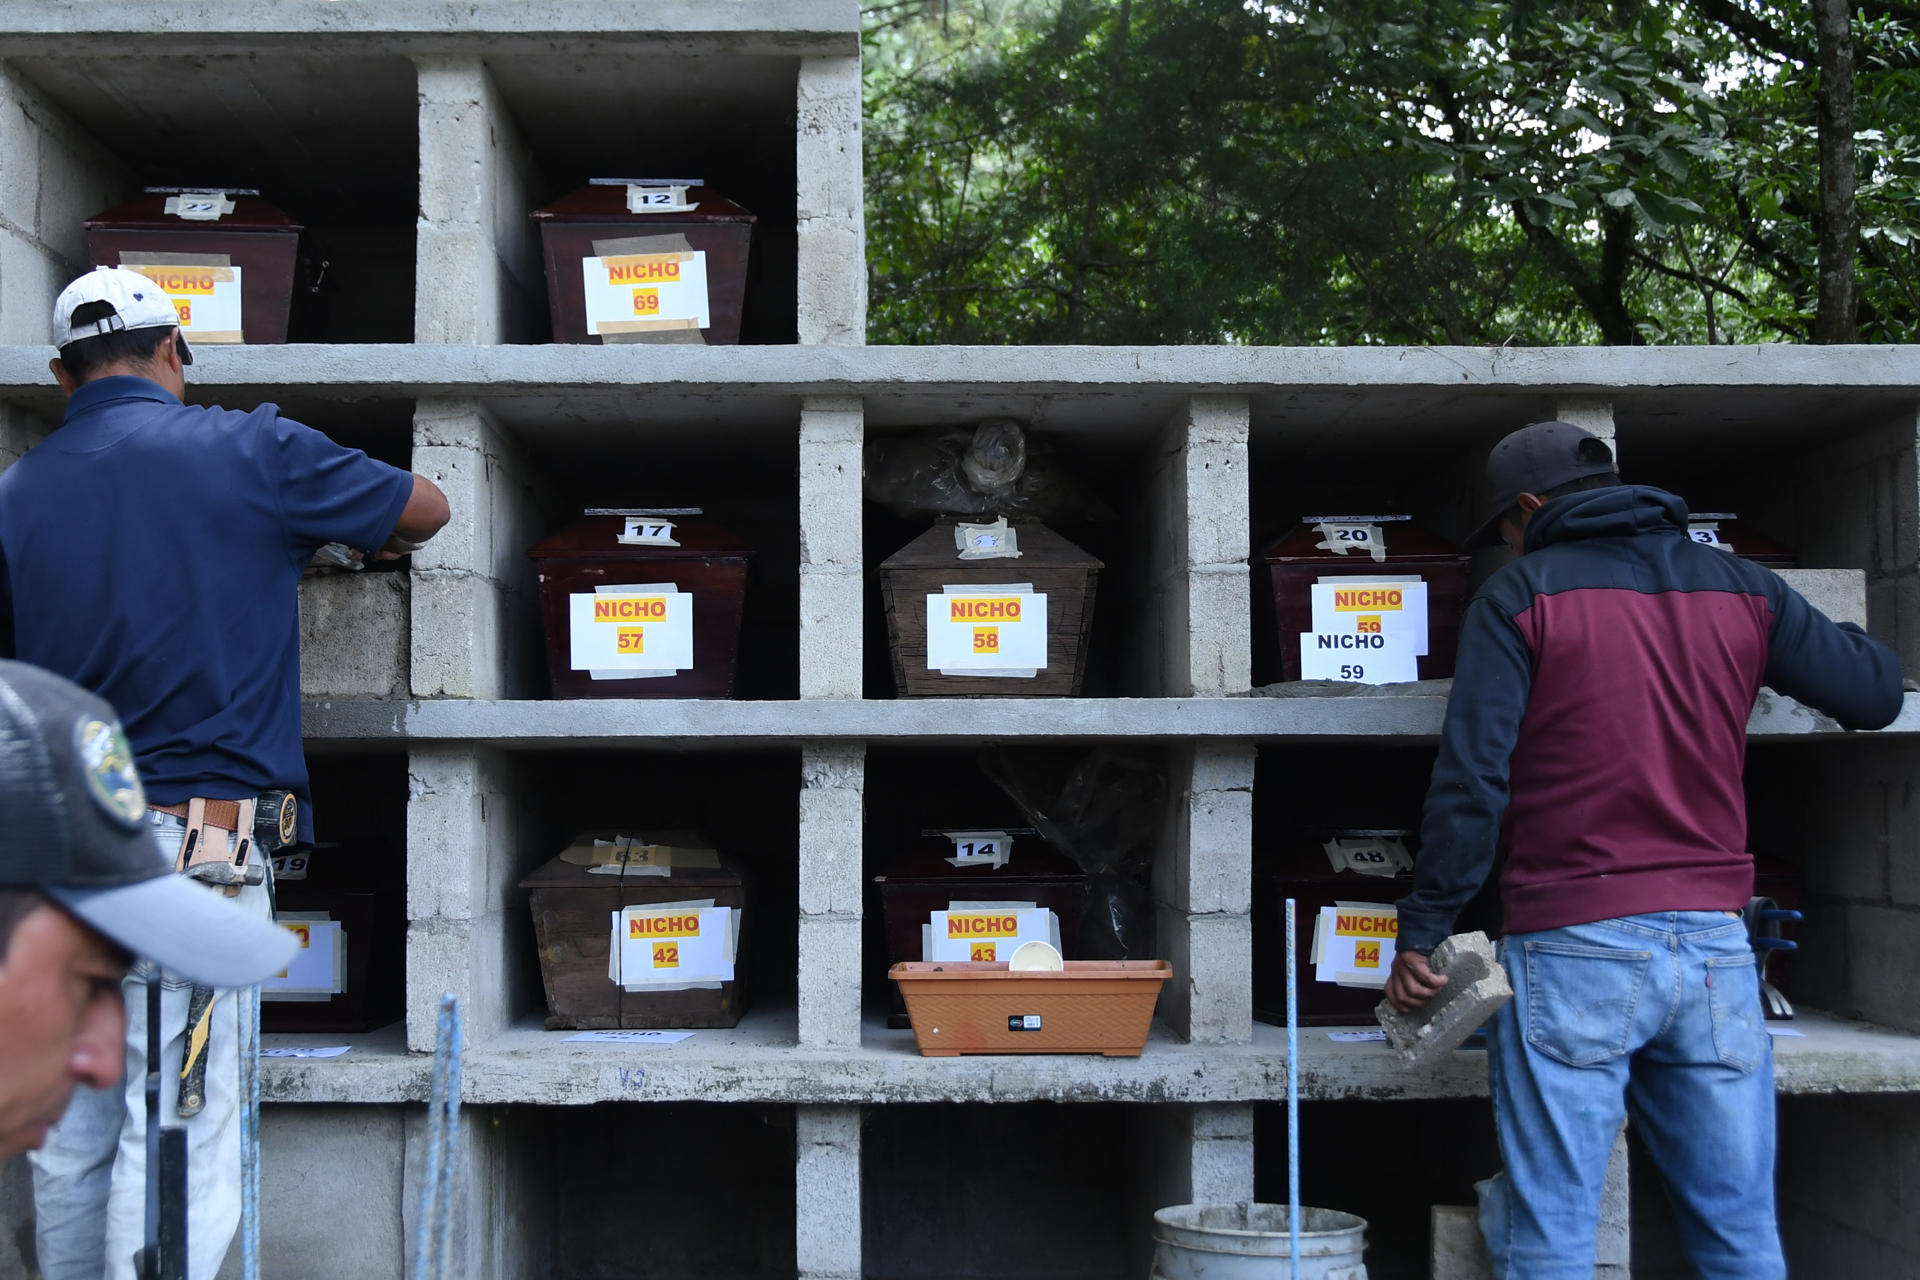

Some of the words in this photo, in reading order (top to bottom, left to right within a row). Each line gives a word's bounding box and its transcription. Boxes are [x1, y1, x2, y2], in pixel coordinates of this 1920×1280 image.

[640, 194, 671, 204] 12
[609, 262, 680, 280] NICHO
[633, 295, 659, 310] 69
[631, 525, 666, 537] 17
[1337, 530, 1368, 541] 20
[1335, 591, 1402, 606] NICHO
[595, 602, 666, 617] NICHO
[951, 602, 1021, 617] NICHO
[1357, 621, 1382, 633] 59
[618, 633, 643, 648] 57
[974, 633, 999, 648] 58
[1318, 634, 1385, 649] NICHO
[1340, 664, 1364, 679] 59
[962, 843, 996, 856] 14
[274, 858, 306, 871] 19
[1353, 852, 1385, 863] 48
[629, 916, 699, 934] NICHO
[948, 917, 1018, 933] NICHO
[653, 948, 679, 963] 42
[970, 948, 996, 962] 43
[1355, 947, 1380, 962] 44
